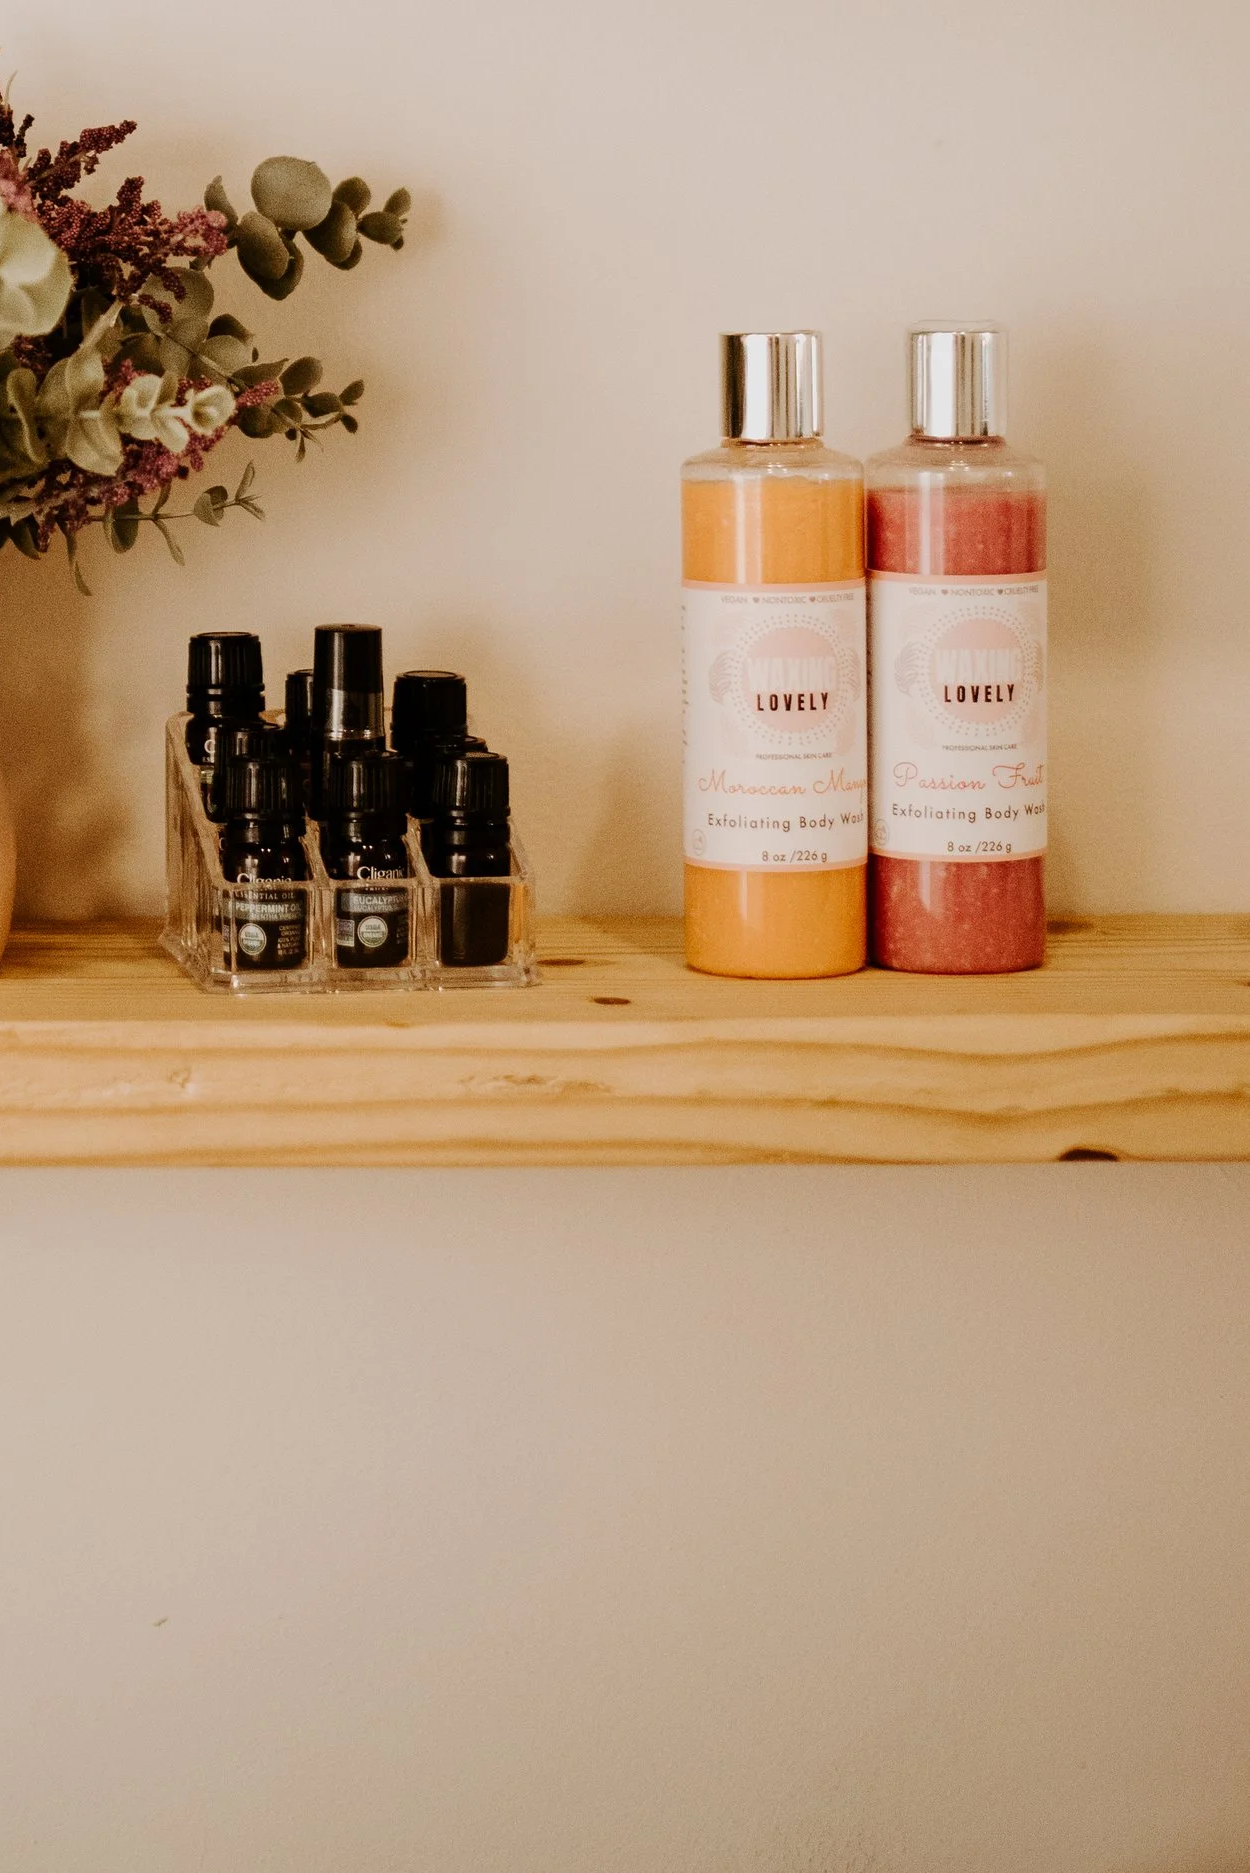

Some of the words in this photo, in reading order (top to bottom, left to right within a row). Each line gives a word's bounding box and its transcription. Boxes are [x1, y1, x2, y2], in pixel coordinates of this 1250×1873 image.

[908, 586, 937, 595] VEGAN
[950, 588, 996, 596] NONTOXIC
[1004, 586, 1030, 596] CRUELTY
[720, 595, 748, 604] VEGAN
[761, 595, 807, 604] NONTOXIC
[816, 594, 842, 603] CRUELTY
[843, 593, 854, 602] FREE
[944, 684, 1015, 703] LOVELY
[756, 692, 829, 711] LOVELY
[942, 744, 989, 752] PROFESSIONAL
[989, 744, 1003, 752] SKIN
[1004, 743, 1018, 751] CARE
[755, 752, 802, 760] PROFESSIONAL
[803, 752, 817, 760] SKIN
[892, 761, 987, 790] Passion
[992, 762, 1045, 789] Fruit
[698, 768, 807, 796] Moroccan
[892, 803, 977, 823] Exfoliating
[984, 804, 1020, 821] Body
[707, 813, 791, 832] Exfoliating
[799, 813, 835, 830] Body
[947, 841, 954, 853] 8
[958, 844, 972, 853] oz
[762, 850, 769, 862] 8
[772, 853, 786, 862] oz
[281, 892, 295, 900] OIL
[235, 901, 289, 914] PEPPERMINT
